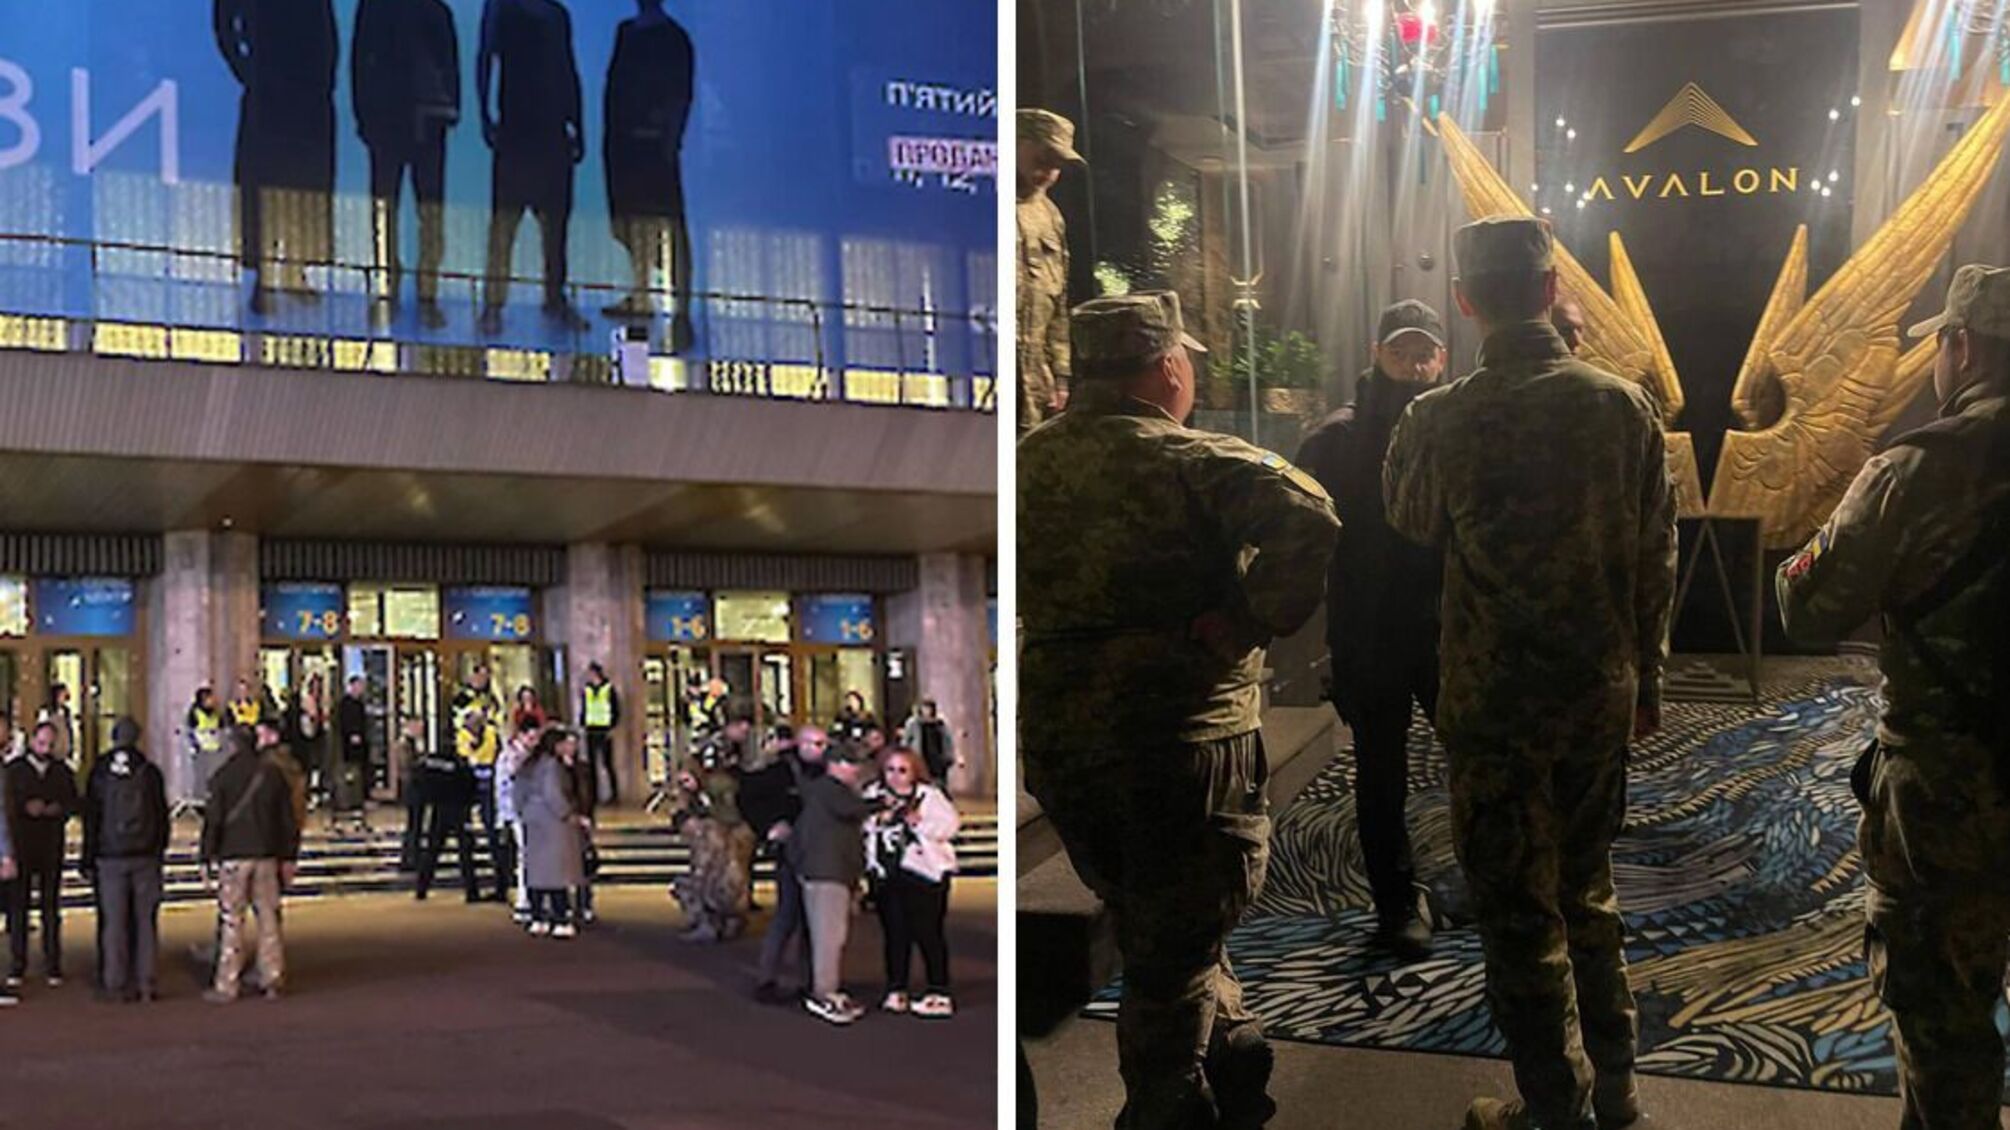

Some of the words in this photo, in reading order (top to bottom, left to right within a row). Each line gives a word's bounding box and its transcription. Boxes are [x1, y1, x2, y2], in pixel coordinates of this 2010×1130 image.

[1588, 167, 1800, 200] AVALON
[298, 609, 339, 635] 7-8
[490, 612, 531, 636] 7-8
